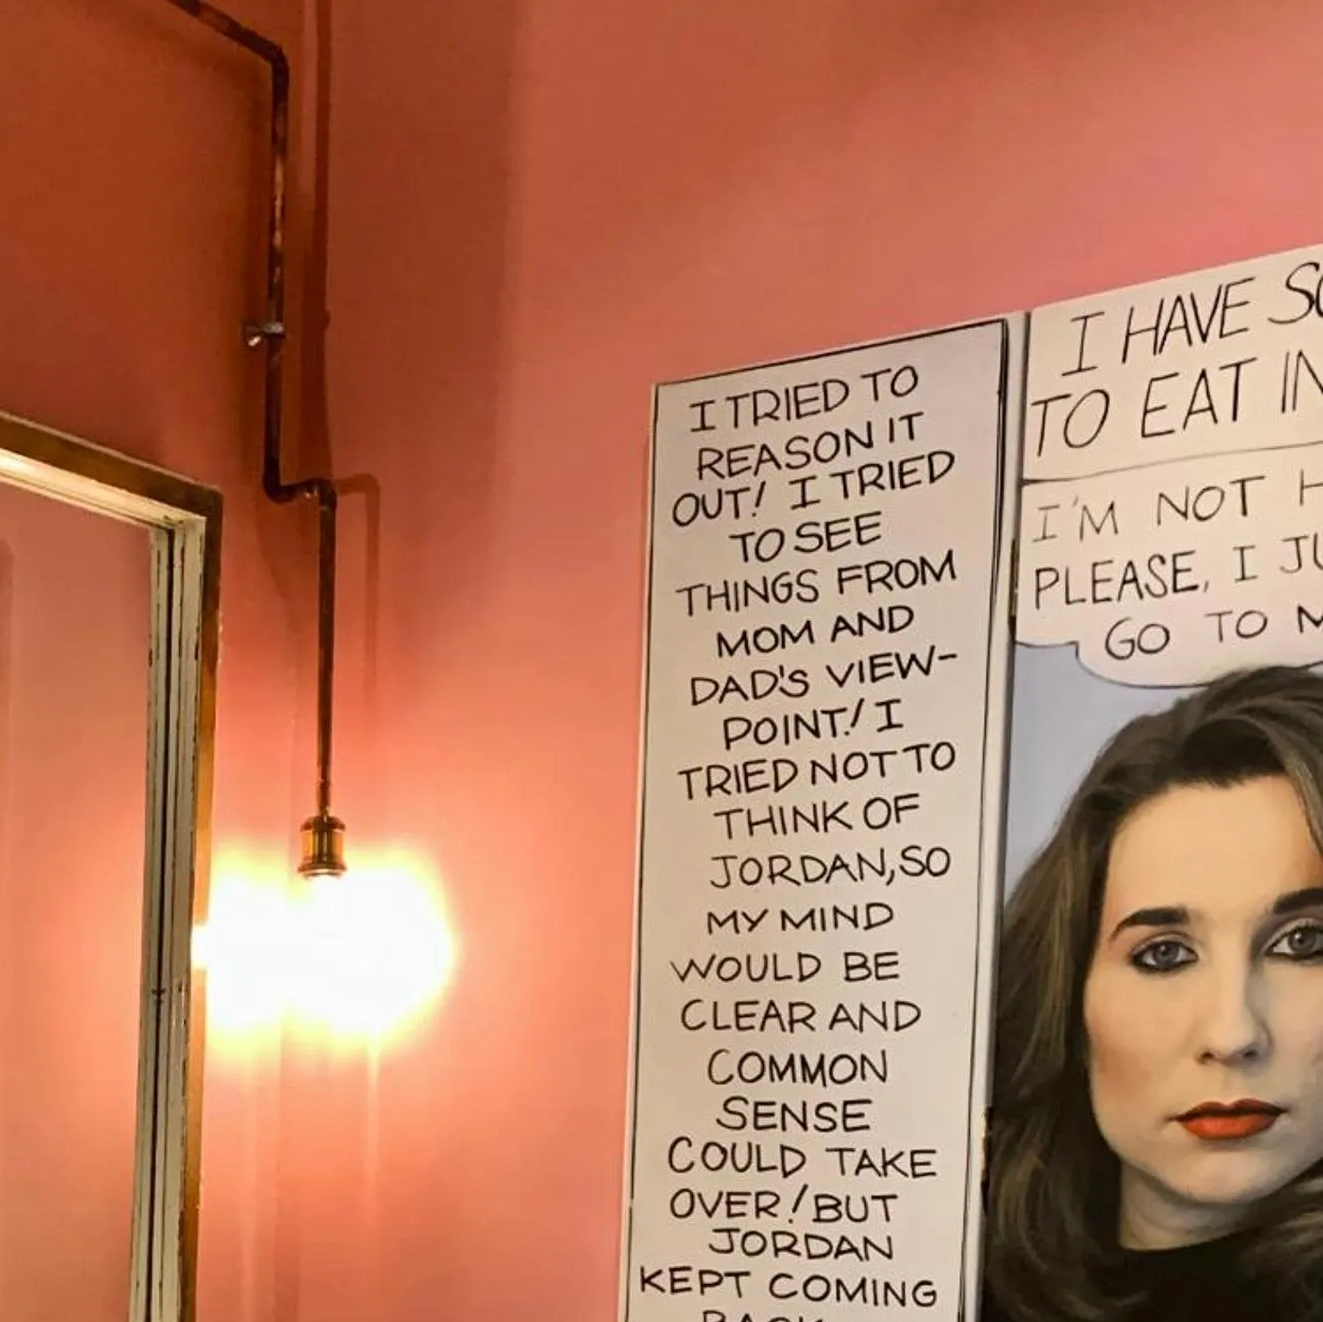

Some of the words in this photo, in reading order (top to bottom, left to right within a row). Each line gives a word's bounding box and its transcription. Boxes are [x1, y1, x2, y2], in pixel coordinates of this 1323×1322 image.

[1061, 311, 1105, 377] I
[1121, 274, 1257, 365] HAVE
[1267, 261, 1323, 325] S
[689, 400, 717, 432] I
[725, 379, 850, 429] TRIED
[860, 365, 919, 402] TO
[1031, 389, 1110, 457] TO
[1141, 357, 1258, 439] EAT
[696, 420, 875, 481] REASON
[889, 411, 924, 444] IT
[672, 480, 766, 528] OUT!
[788, 474, 821, 510] I
[829, 450, 956, 500] TRIED
[1033, 497, 1119, 542] I'M
[1157, 475, 1266, 527] NOT
[728, 528, 785, 563] TO
[793, 510, 882, 554] SEE
[675, 569, 819, 617] THINGS
[837, 548, 957, 595] FROM
[1035, 550, 1209, 611] PLEASE,
[1233, 545, 1258, 583] I
[716, 620, 816, 658] MOM
[830, 605, 914, 643] AND
[1104, 617, 1170, 661] GO
[1205, 610, 1268, 643] TO
[690, 664, 810, 706] DAD'S
[825, 644, 958, 688] VIEW-
[723, 697, 865, 751] POINT!
[874, 698, 904, 733] I
[677, 758, 799, 800] TRIED
[810, 750, 898, 786] NOT
[902, 741, 956, 774] TO
[713, 800, 853, 840] THINK
[863, 793, 920, 830] OF
[710, 847, 895, 889] JORDAN,
[899, 844, 951, 877] SO
[707, 908, 769, 935] MY
[780, 902, 894, 932] MIND
[670, 952, 822, 983] WOULD
[843, 951, 900, 983] BE
[681, 998, 817, 1034] CLEAR
[828, 1000, 921, 1034] AND
[707, 1048, 887, 1089] COMMON
[716, 1095, 873, 1133] SENSE
[668, 1136, 807, 1179] COULD
[825, 1147, 937, 1179] TAKE
[670, 1183, 809, 1224] OVER!
[812, 1193, 898, 1223] BUT
[708, 1227, 893, 1262] JORDAN
[640, 1265, 752, 1299] KEPT
[769, 1273, 937, 1308] COMING
